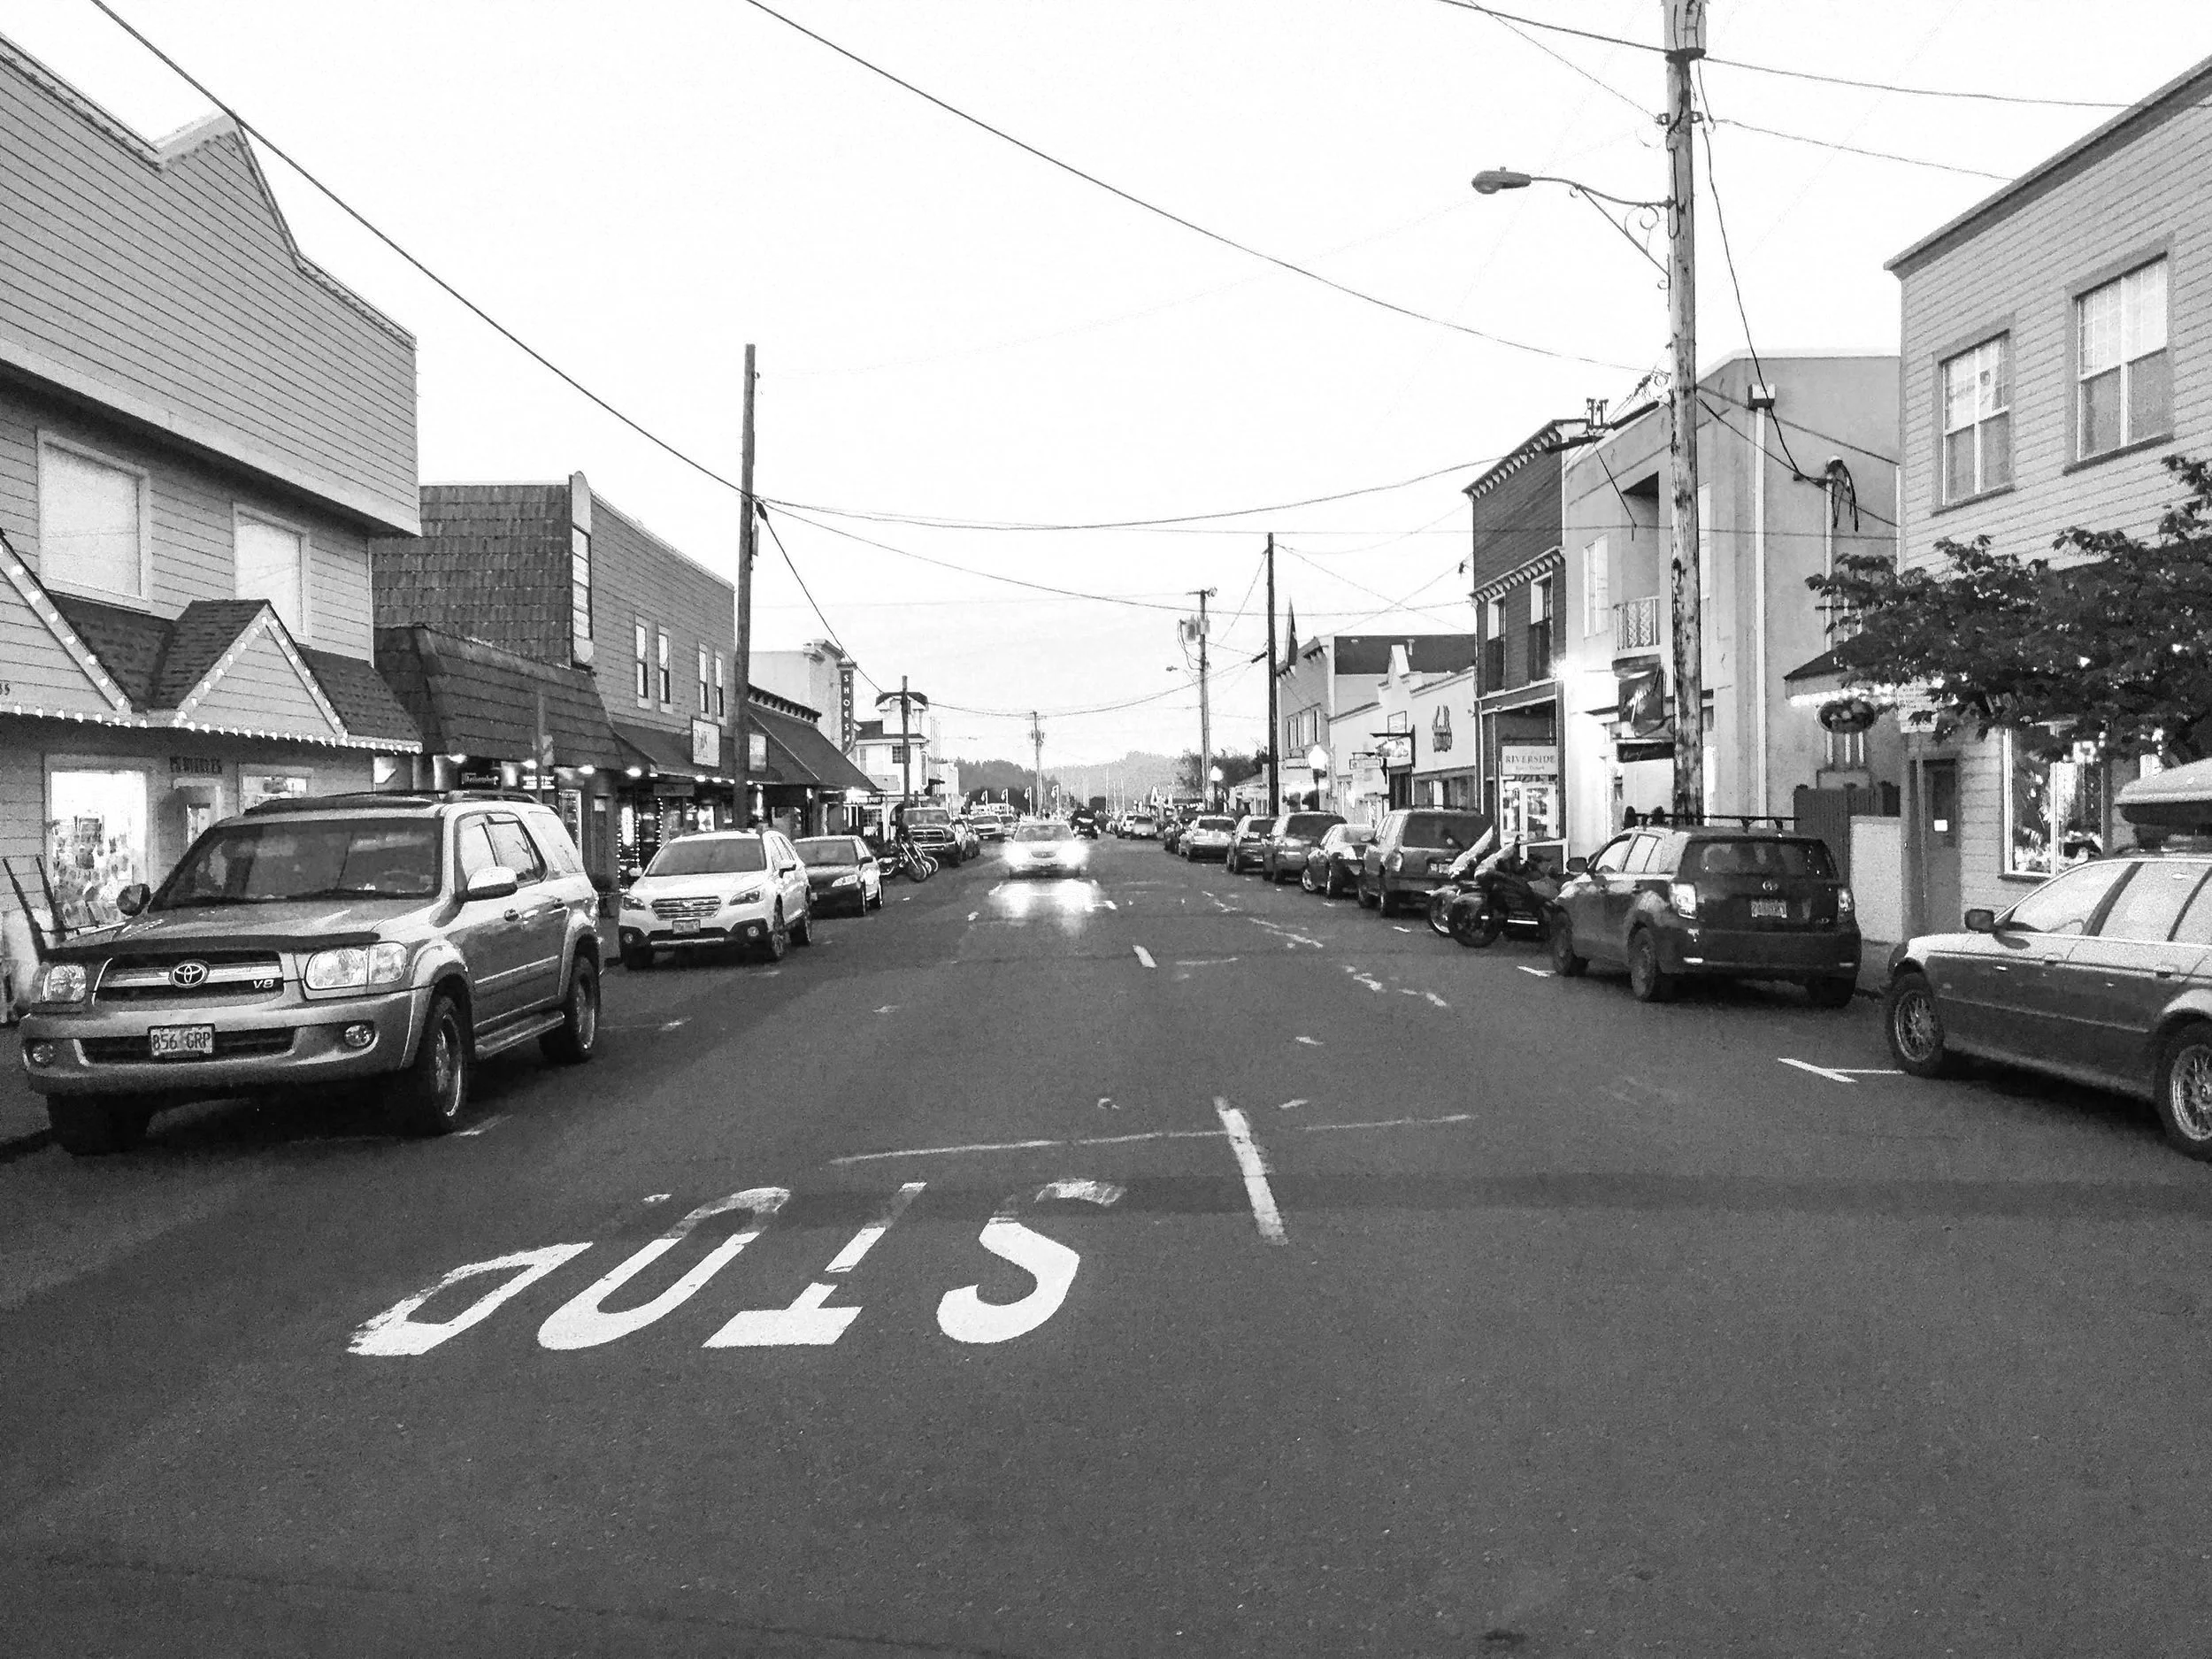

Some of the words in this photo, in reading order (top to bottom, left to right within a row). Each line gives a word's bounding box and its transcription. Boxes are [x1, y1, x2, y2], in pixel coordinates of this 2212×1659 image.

[1506, 755, 1555, 764] RIVERSIDE
[253, 979, 274, 989] V8
[186, 1032, 210, 1048] GRP
[347, 1179, 1125, 1356] STOP
